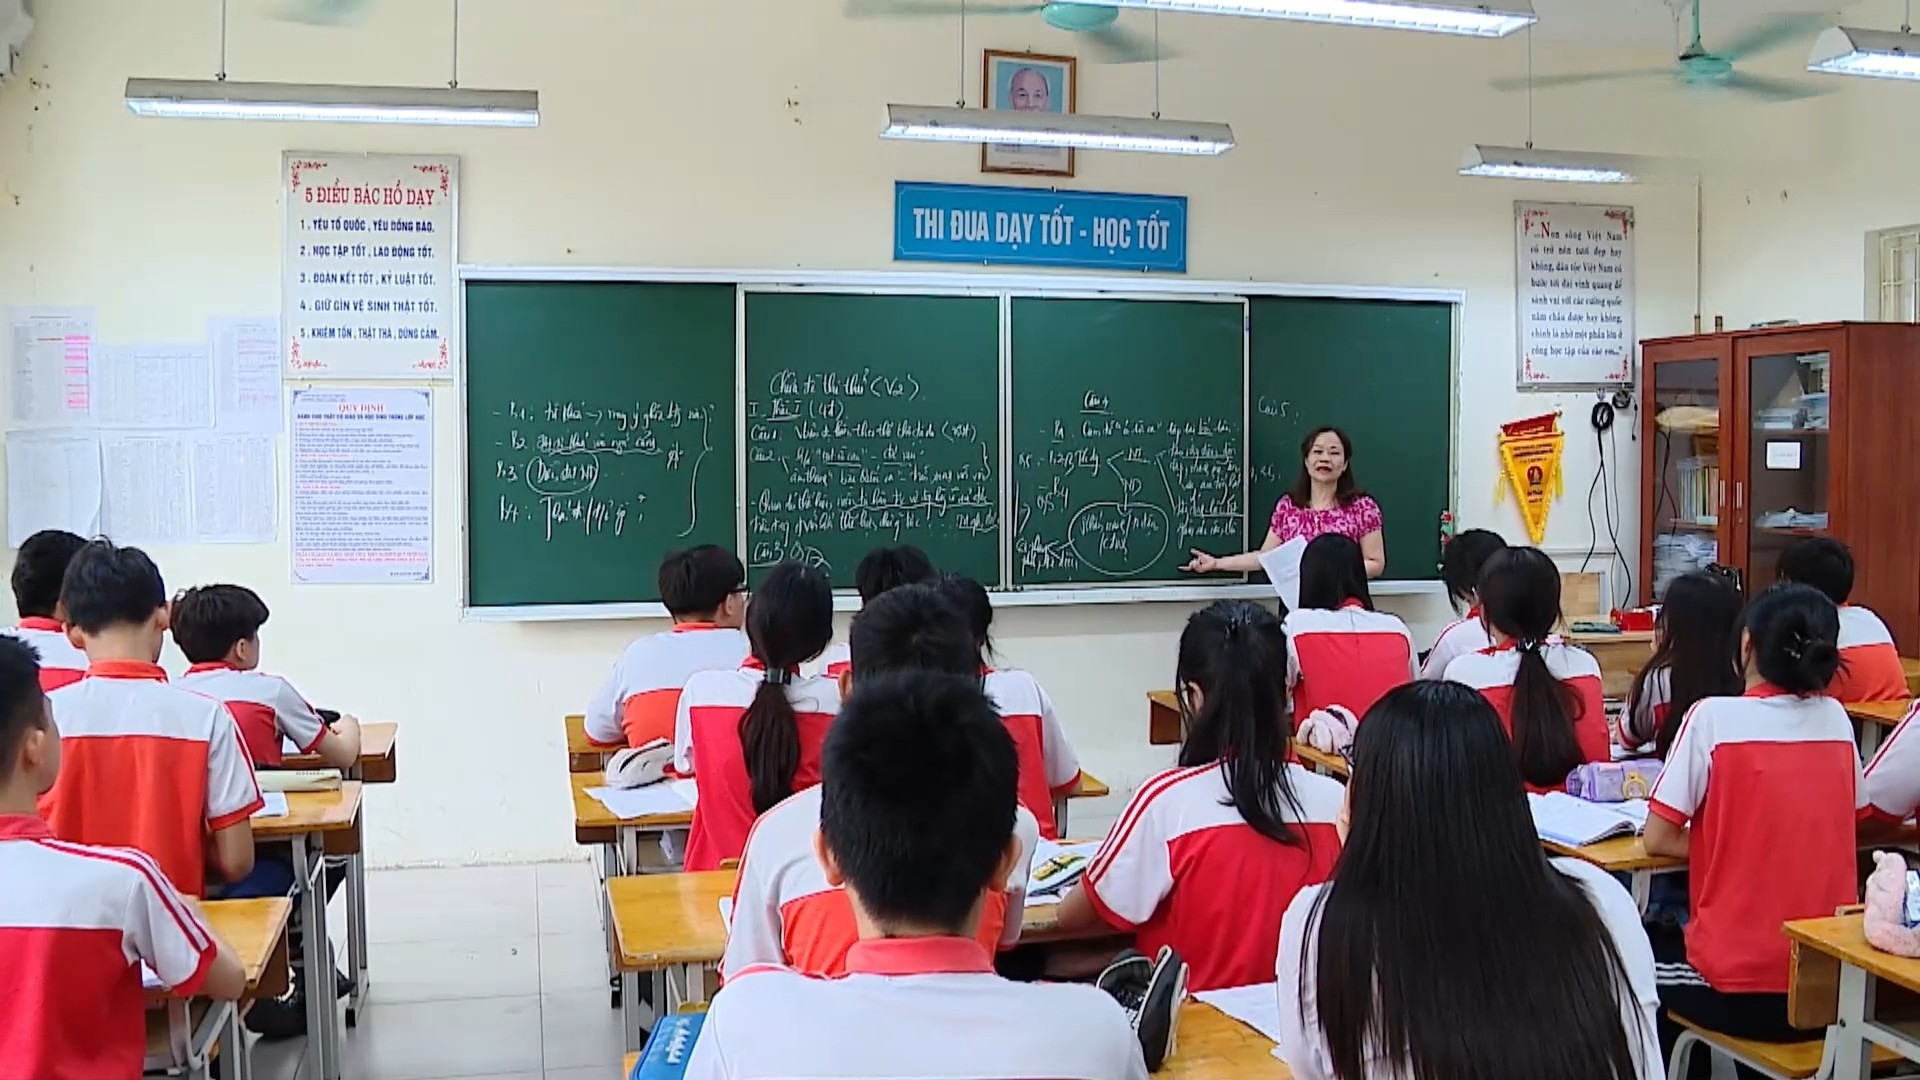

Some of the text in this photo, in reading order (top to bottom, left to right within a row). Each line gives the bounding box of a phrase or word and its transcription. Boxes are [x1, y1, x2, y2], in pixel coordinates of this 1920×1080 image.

[305, 187, 313, 203] 5
[354, 182, 380, 205] BÁC
[407, 188, 435, 209] DẠY
[313, 218, 329, 230] YÊU
[373, 218, 388, 231] YÊU
[913, 207, 944, 240] THI
[950, 209, 990, 242] ĐUA
[995, 211, 1034, 251] DẠY
[1039, 204, 1074, 246] TỐT
[1093, 216, 1131, 255] HỌC
[1136, 209, 1170, 251] TỐT
[1587, 229, 1601, 242] Việt
[1606, 230, 1622, 241] Nam
[313, 245, 330, 259] HỌC
[333, 244, 349, 259] TẬP
[373, 246, 389, 257] LAO
[392, 245, 415, 260] ĐỘNG
[1610, 246, 1622, 258] hay
[1583, 262, 1596, 274] Việt
[1598, 263, 1613, 273] Nam
[340, 270, 355, 285] KẾT
[395, 271, 415, 287] LUẬT
[1592, 281, 1612, 291] quang
[333, 297, 350, 311] GÌN
[367, 301, 390, 312] SINH
[393, 300, 415, 315] THẬT
[311, 325, 336, 339] KHIÊM
[358, 326, 376, 341] THẬT
